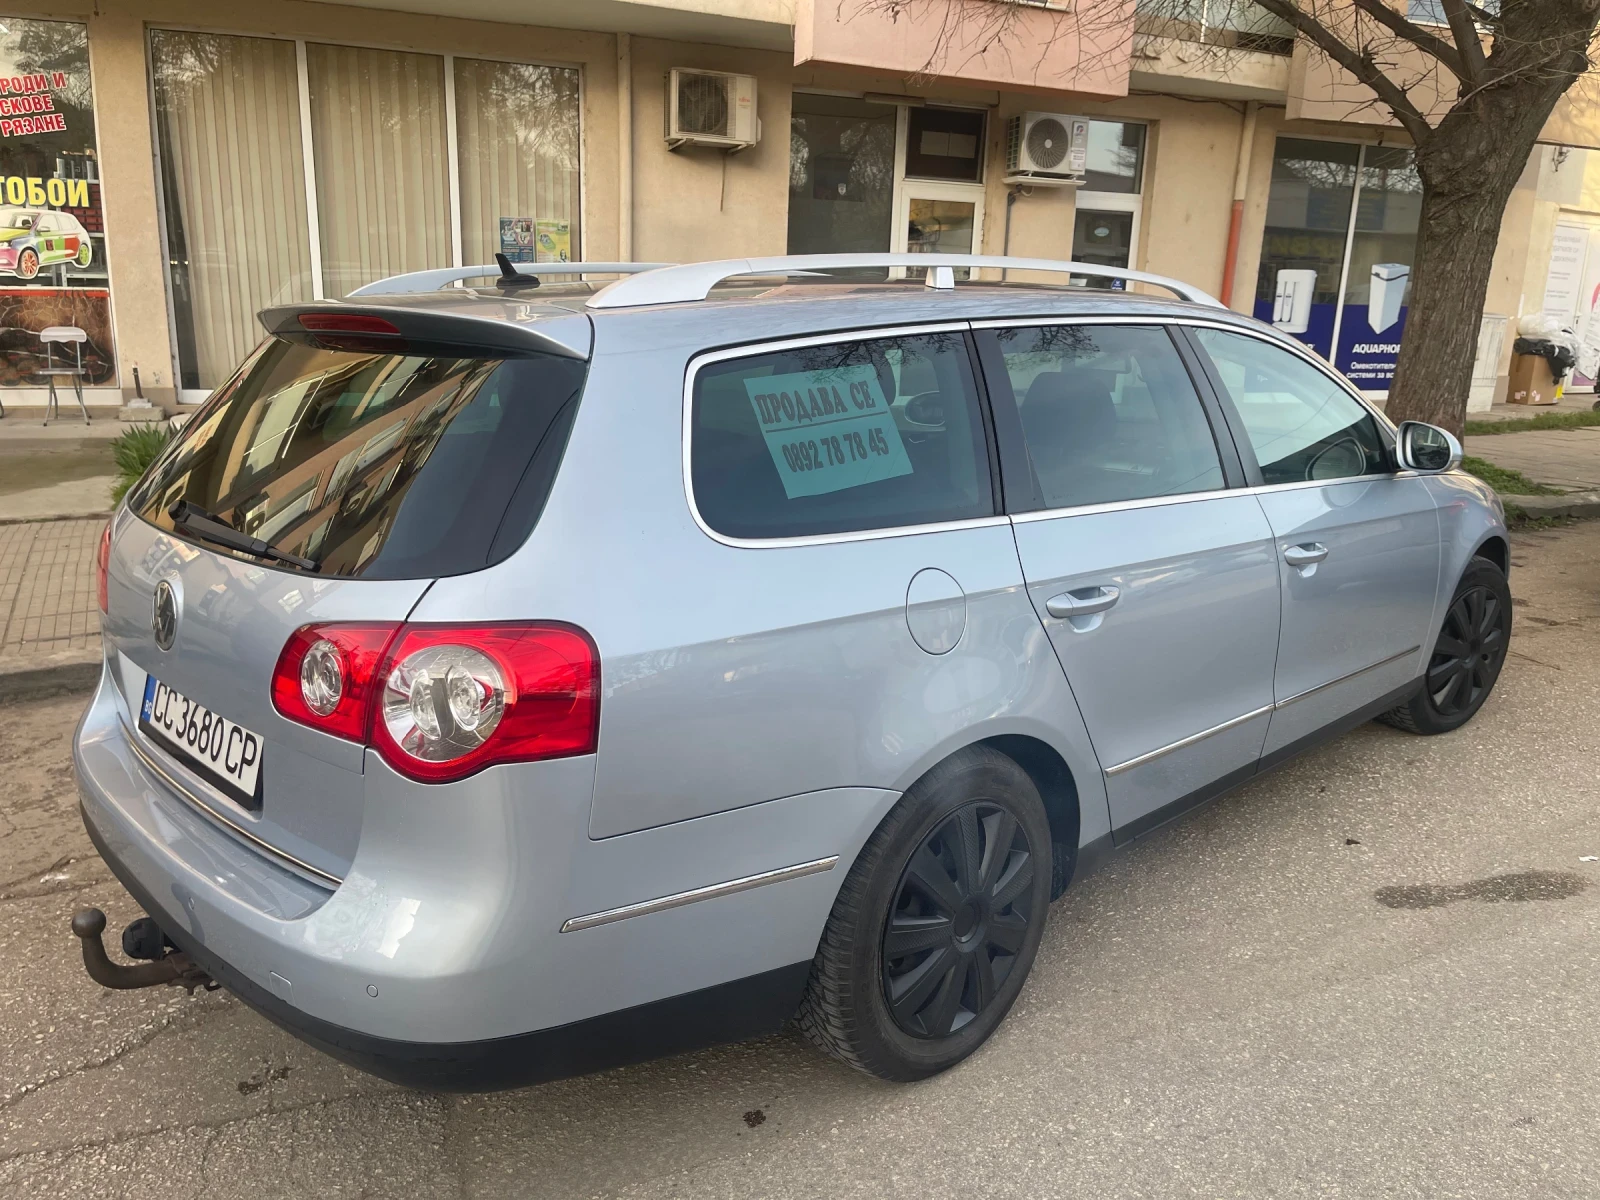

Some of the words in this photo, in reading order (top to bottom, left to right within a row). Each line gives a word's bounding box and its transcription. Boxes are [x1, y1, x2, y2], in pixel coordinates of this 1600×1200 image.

[52, 72, 67, 88] И
[0, 93, 54, 116] СКОВЕ
[0, 113, 67, 137] РЯЗАНЕ
[754, 385, 849, 425] ПРОДАВА
[850, 380, 877, 410] СЕ
[781, 440, 824, 473] 0892
[820, 435, 846, 467] 78
[842, 431, 868, 462] 78
[868, 427, 890, 457] 45
[144, 699, 153, 715] BG
